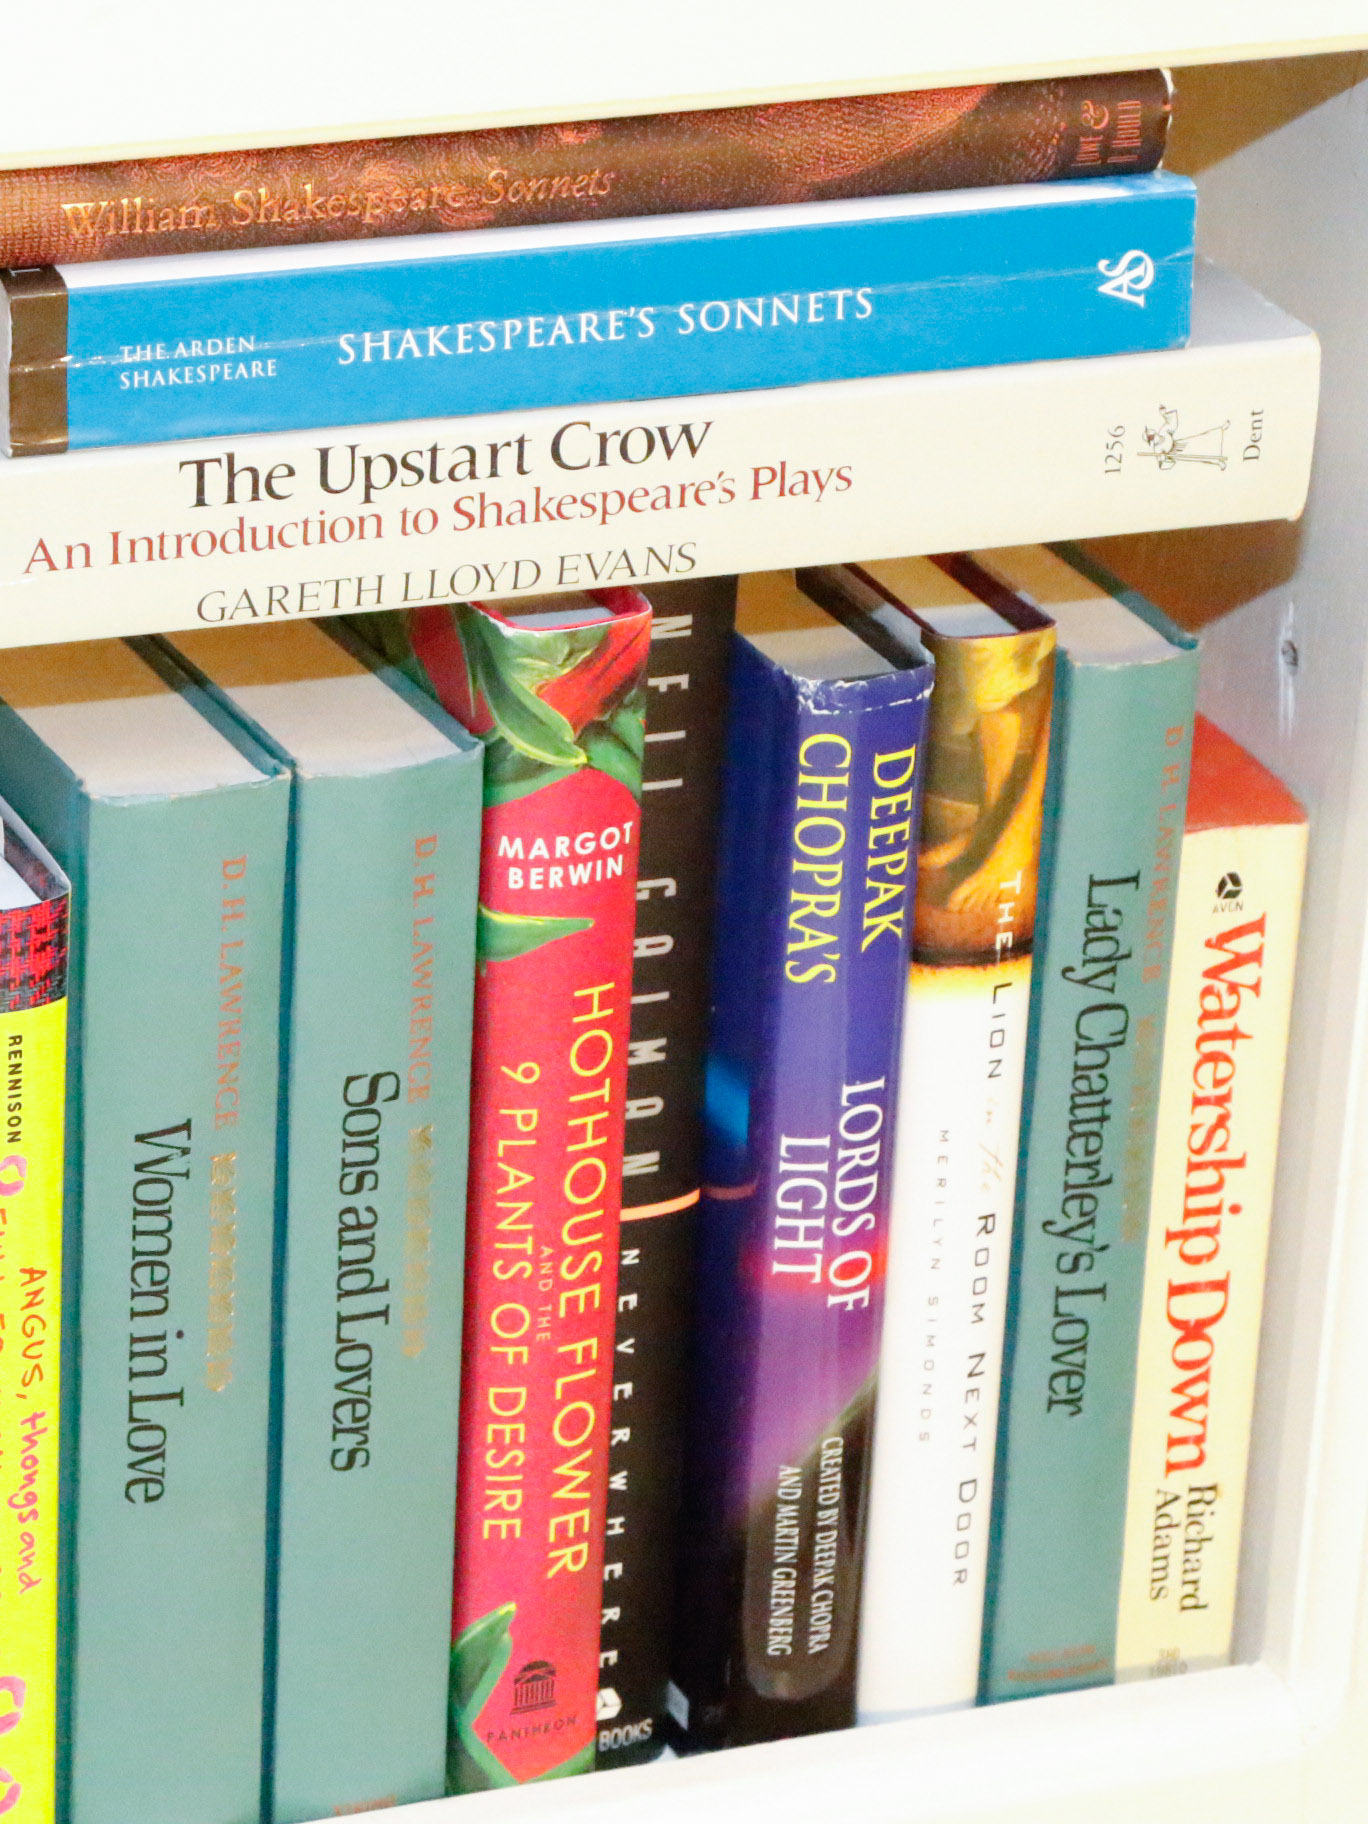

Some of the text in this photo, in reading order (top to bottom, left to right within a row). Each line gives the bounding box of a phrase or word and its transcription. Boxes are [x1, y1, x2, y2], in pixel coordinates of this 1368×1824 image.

[61, 167, 615, 237] William Shakespeare Sonnets
[119, 359, 278, 390] SHAKESPEARE
[120, 336, 256, 361] THE ARDEN
[338, 287, 874, 365] SHAKESPEARE'S SONNETS
[179, 420, 715, 509] The Upstart Crow
[1103, 424, 1126, 476] 1256
[1242, 409, 1264, 463] Dent
[23, 460, 854, 575] An Introduction to Shakespeare's Plays
[198, 541, 697, 624] GARETH LLOYD EVANS
[498, 821, 633, 860] MARGOT
[507, 855, 622, 889] BERWIN
[786, 733, 851, 984] CHOPRA'S
[861, 743, 917, 953] DEEPAK
[995, 870, 1022, 951] THE
[214, 855, 247, 1131] D. H. LAWRENCE
[407, 834, 438, 1104] D. H. LAWRENCE
[987, 982, 1012, 1079] LION
[7, 1034, 23, 1144] RENNISON
[1042, 869, 1141, 1418] Lady Chatterley's Lover
[773, 1134, 831, 1284] LIGHT
[827, 1076, 887, 1312] LORDS OF
[1164, 913, 1266, 1479] Watership Down
[124, 1118, 192, 1505] Women in Love
[330, 1069, 401, 1472] Sons and Lovers
[483, 1062, 540, 1540] 9 PLANTS OF DESIRE
[537, 1244, 554, 1343] AND THE
[547, 983, 615, 1580] HOTHOUSE FLOWER
[919, 1129, 949, 1442] MERILYN SIMONDS
[970, 1213, 996, 1325] ROOM
[7, 1267, 48, 1595] ANGUS, thongs and
[962, 1352, 986, 1452] NEXT
[767, 1464, 802, 1656] AND MARTIN GREENBERG
[808, 1437, 844, 1655] CREATED BY DEEPAK CHOPRA
[953, 1479, 978, 1586] DOOR
[1150, 1488, 1181, 1602] Adams
[1179, 1481, 1219, 1614] Richard
[487, 1715, 577, 1742] PANTHEON
[599, 1718, 653, 1751] BOOKS
